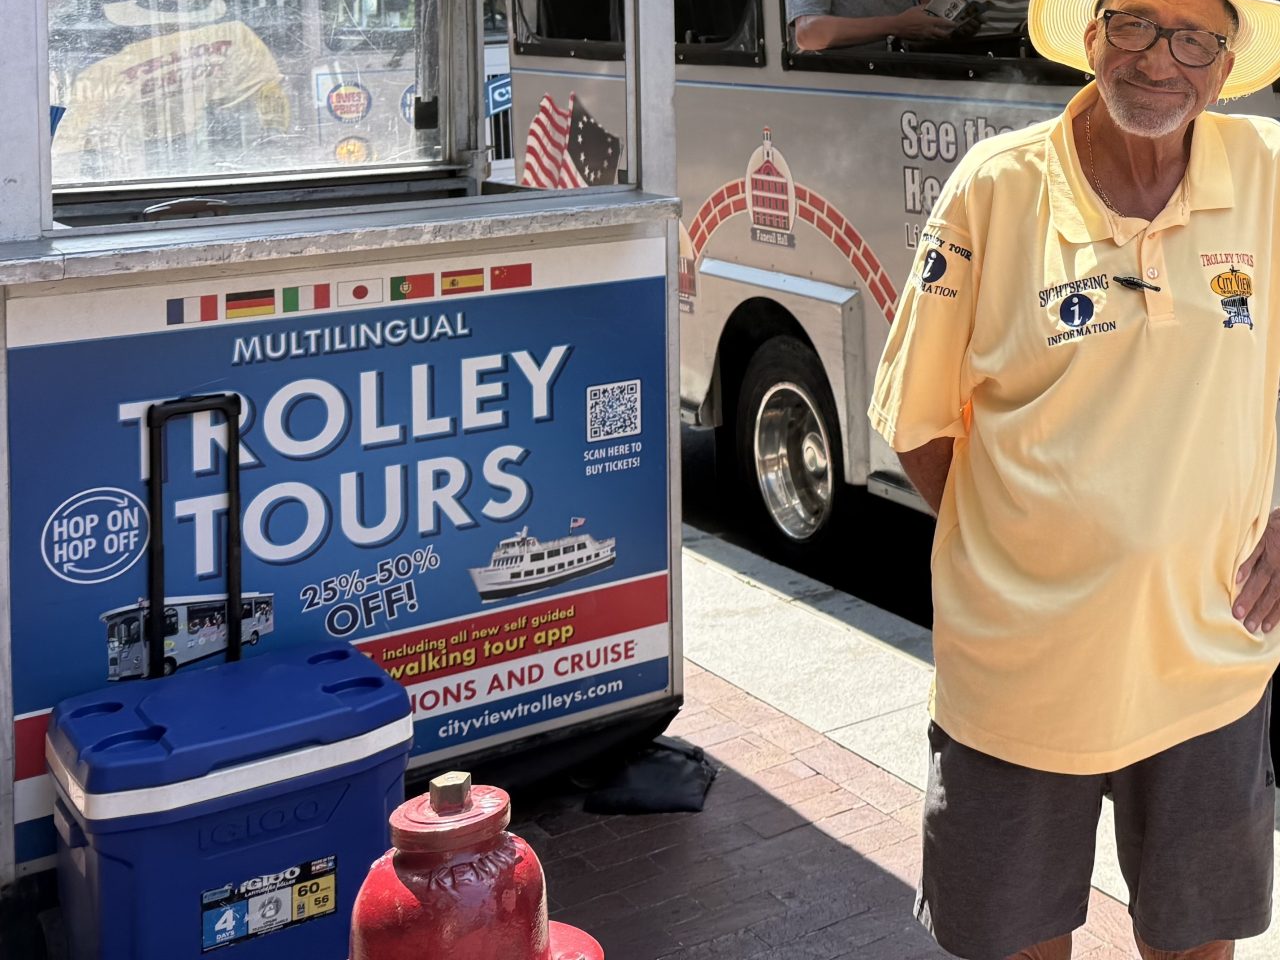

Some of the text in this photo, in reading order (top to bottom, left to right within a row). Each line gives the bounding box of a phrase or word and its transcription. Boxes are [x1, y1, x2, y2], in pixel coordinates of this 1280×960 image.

[901, 110, 957, 163] See
[949, 243, 973, 261] TOUR
[1201, 253, 1254, 268] TROLLEY TOURS
[922, 282, 958, 298] MATION
[1038, 273, 1110, 308] SIGHTSEEING
[232, 312, 470, 364] MULTILINGUAL
[1047, 320, 1117, 347] INFORMATION
[584, 442, 642, 462] SCAN HERE TO
[585, 457, 640, 476] BUY TICKETS!
[53, 506, 139, 542] HOP ON
[174, 445, 530, 577] TOURS
[54, 530, 139, 564] HOP OFF
[300, 545, 441, 613] 25%-50%
[324, 581, 419, 637] OFF!
[383, 605, 575, 661] including all new self guided
[385, 623, 574, 679] walking tour app
[486, 663, 544, 695] AND
[554, 640, 635, 678] CRUISE
[438, 679, 623, 738] cityviewtrolleys.com
[297, 882, 320, 898] 60
[314, 895, 329, 906] 56
[214, 909, 236, 931] 4
[216, 930, 235, 940] DAYS
